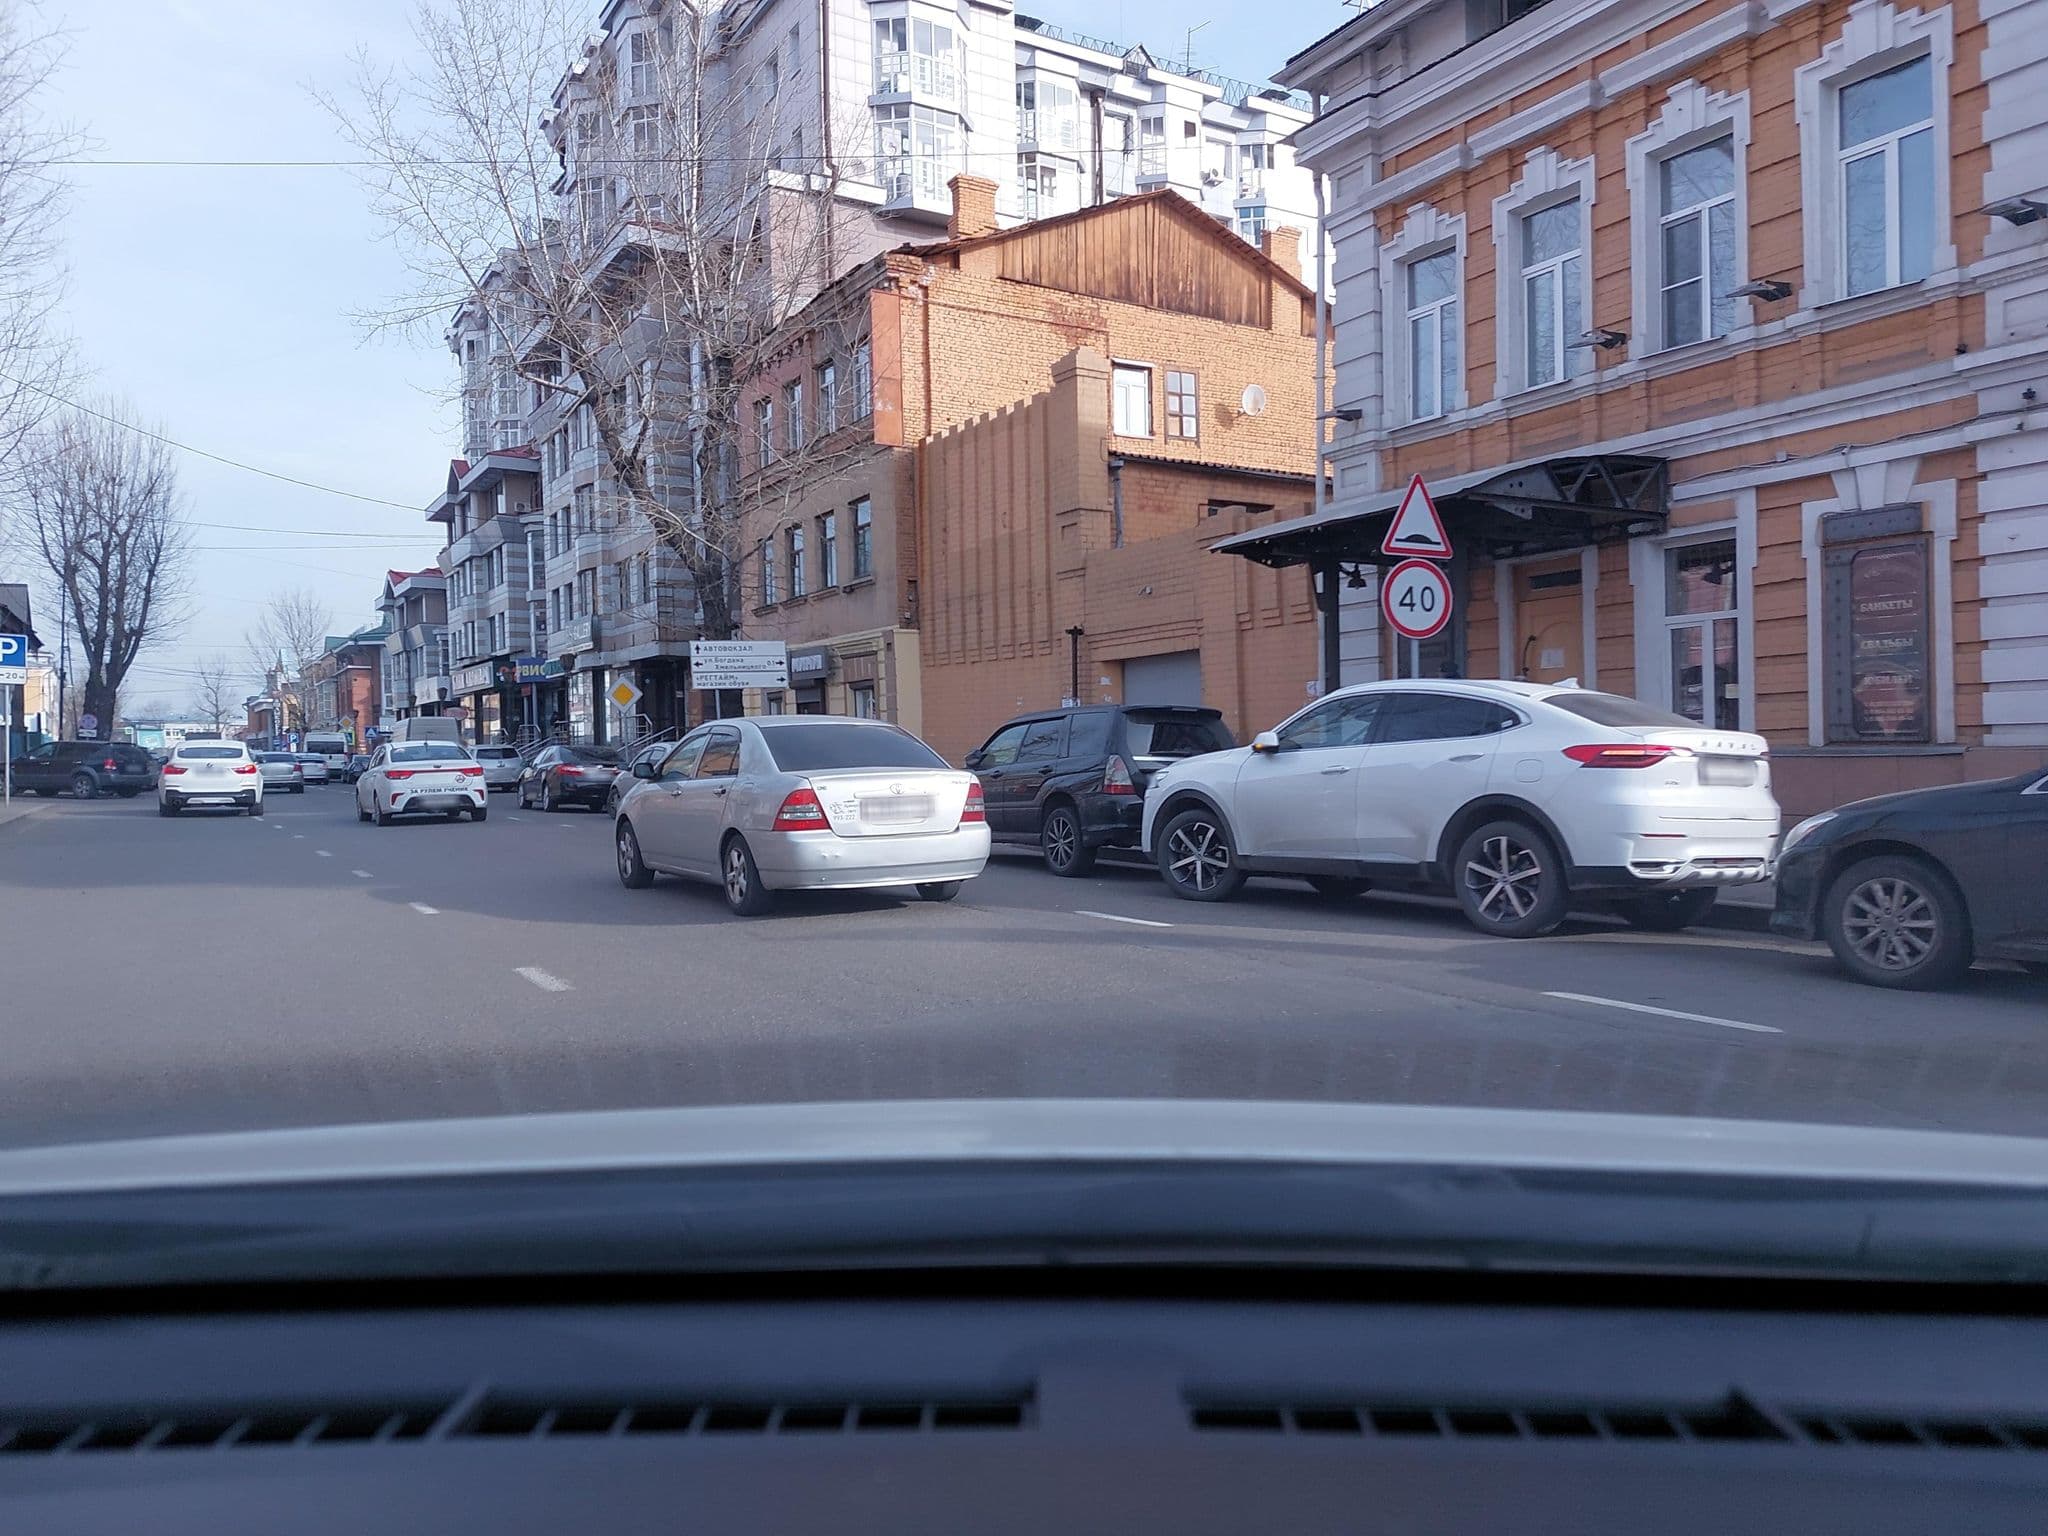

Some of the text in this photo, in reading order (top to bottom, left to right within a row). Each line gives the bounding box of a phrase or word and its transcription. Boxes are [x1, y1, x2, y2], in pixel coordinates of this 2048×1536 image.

[1399, 586, 1434, 612] 40
[1860, 599, 1913, 613] БАНКЕТЫ
[1860, 638, 1913, 650] СВАДЬБЫ
